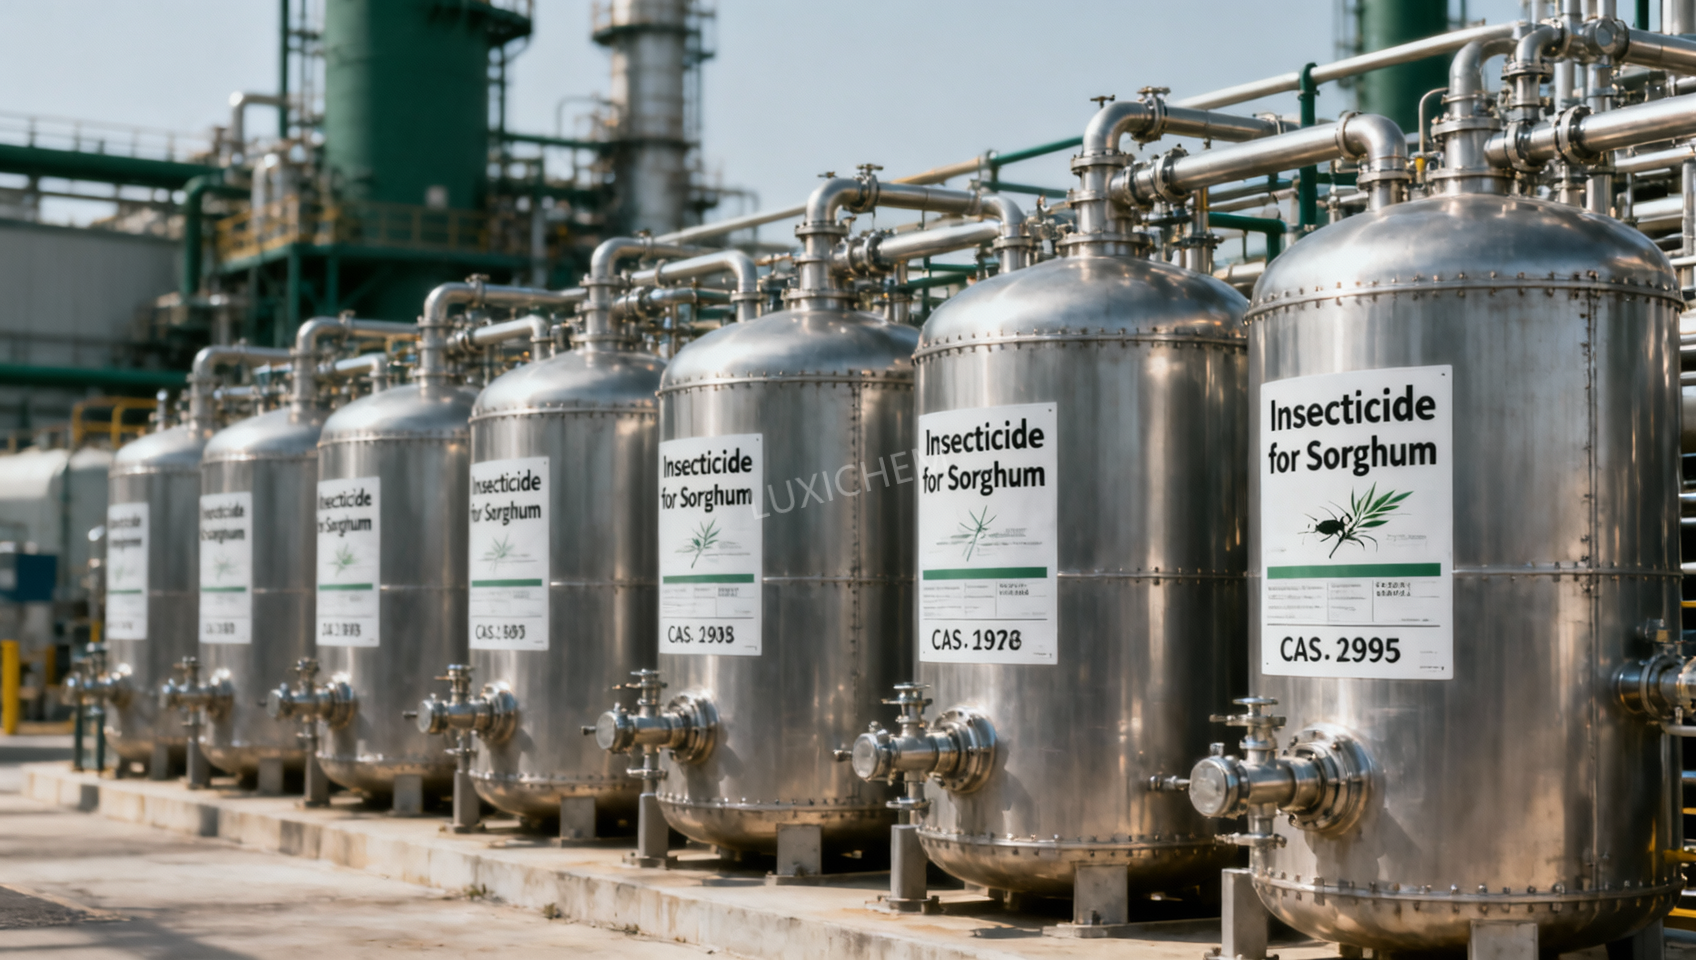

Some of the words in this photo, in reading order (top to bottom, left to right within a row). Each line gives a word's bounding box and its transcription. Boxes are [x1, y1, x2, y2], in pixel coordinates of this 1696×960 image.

[1271, 384, 1437, 431] Insecticide
[926, 418, 1045, 456] Insecticide
[663, 447, 753, 478] Insecticide
[1268, 442, 1300, 474] for
[1306, 435, 1437, 476] Sorghum
[922, 466, 944, 494] for
[948, 460, 1045, 496] Sorghum
[661, 487, 677, 510] for
[680, 483, 752, 513] Sorghum
[668, 625, 693, 643] CAS.
[932, 629, 968, 651] CAS.
[1280, 636, 1330, 662] CAS.
[1336, 637, 1401, 663] 2995
